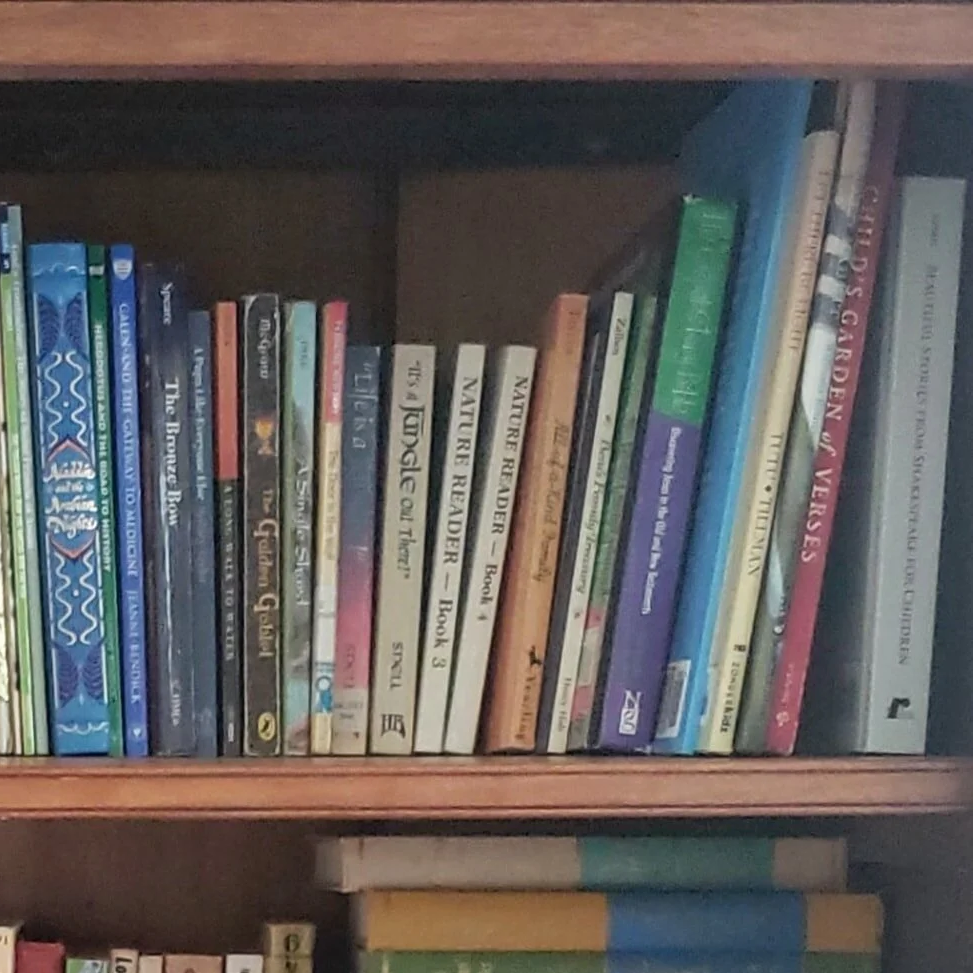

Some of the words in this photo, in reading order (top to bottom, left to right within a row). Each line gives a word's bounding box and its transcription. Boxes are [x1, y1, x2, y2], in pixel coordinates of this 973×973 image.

[162, 282, 174, 325] Speare
[259, 318, 273, 379] McGraw
[830, 310, 858, 421] GARDEN
[164, 376, 180, 415] The
[503, 376, 529, 451] NATURE
[453, 376, 479, 466] NATURE
[818, 432, 836, 457] of
[165, 422, 180, 484] Bronze
[167, 490, 182, 526] Bow
[225, 500, 235, 537] LONG
[262, 489, 274, 515] The
[442, 473, 469, 564] READER
[491, 457, 516, 534] READER
[801, 467, 832, 563] VERSES
[225, 542, 235, 581] WALK
[254, 518, 277, 587] Golden
[225, 589, 235, 607] TO
[479, 564, 496, 605] Book
[225, 612, 235, 661] WATER
[254, 593, 279, 658] Goblet
[434, 600, 452, 648] Book
[432, 656, 446, 669] 3
